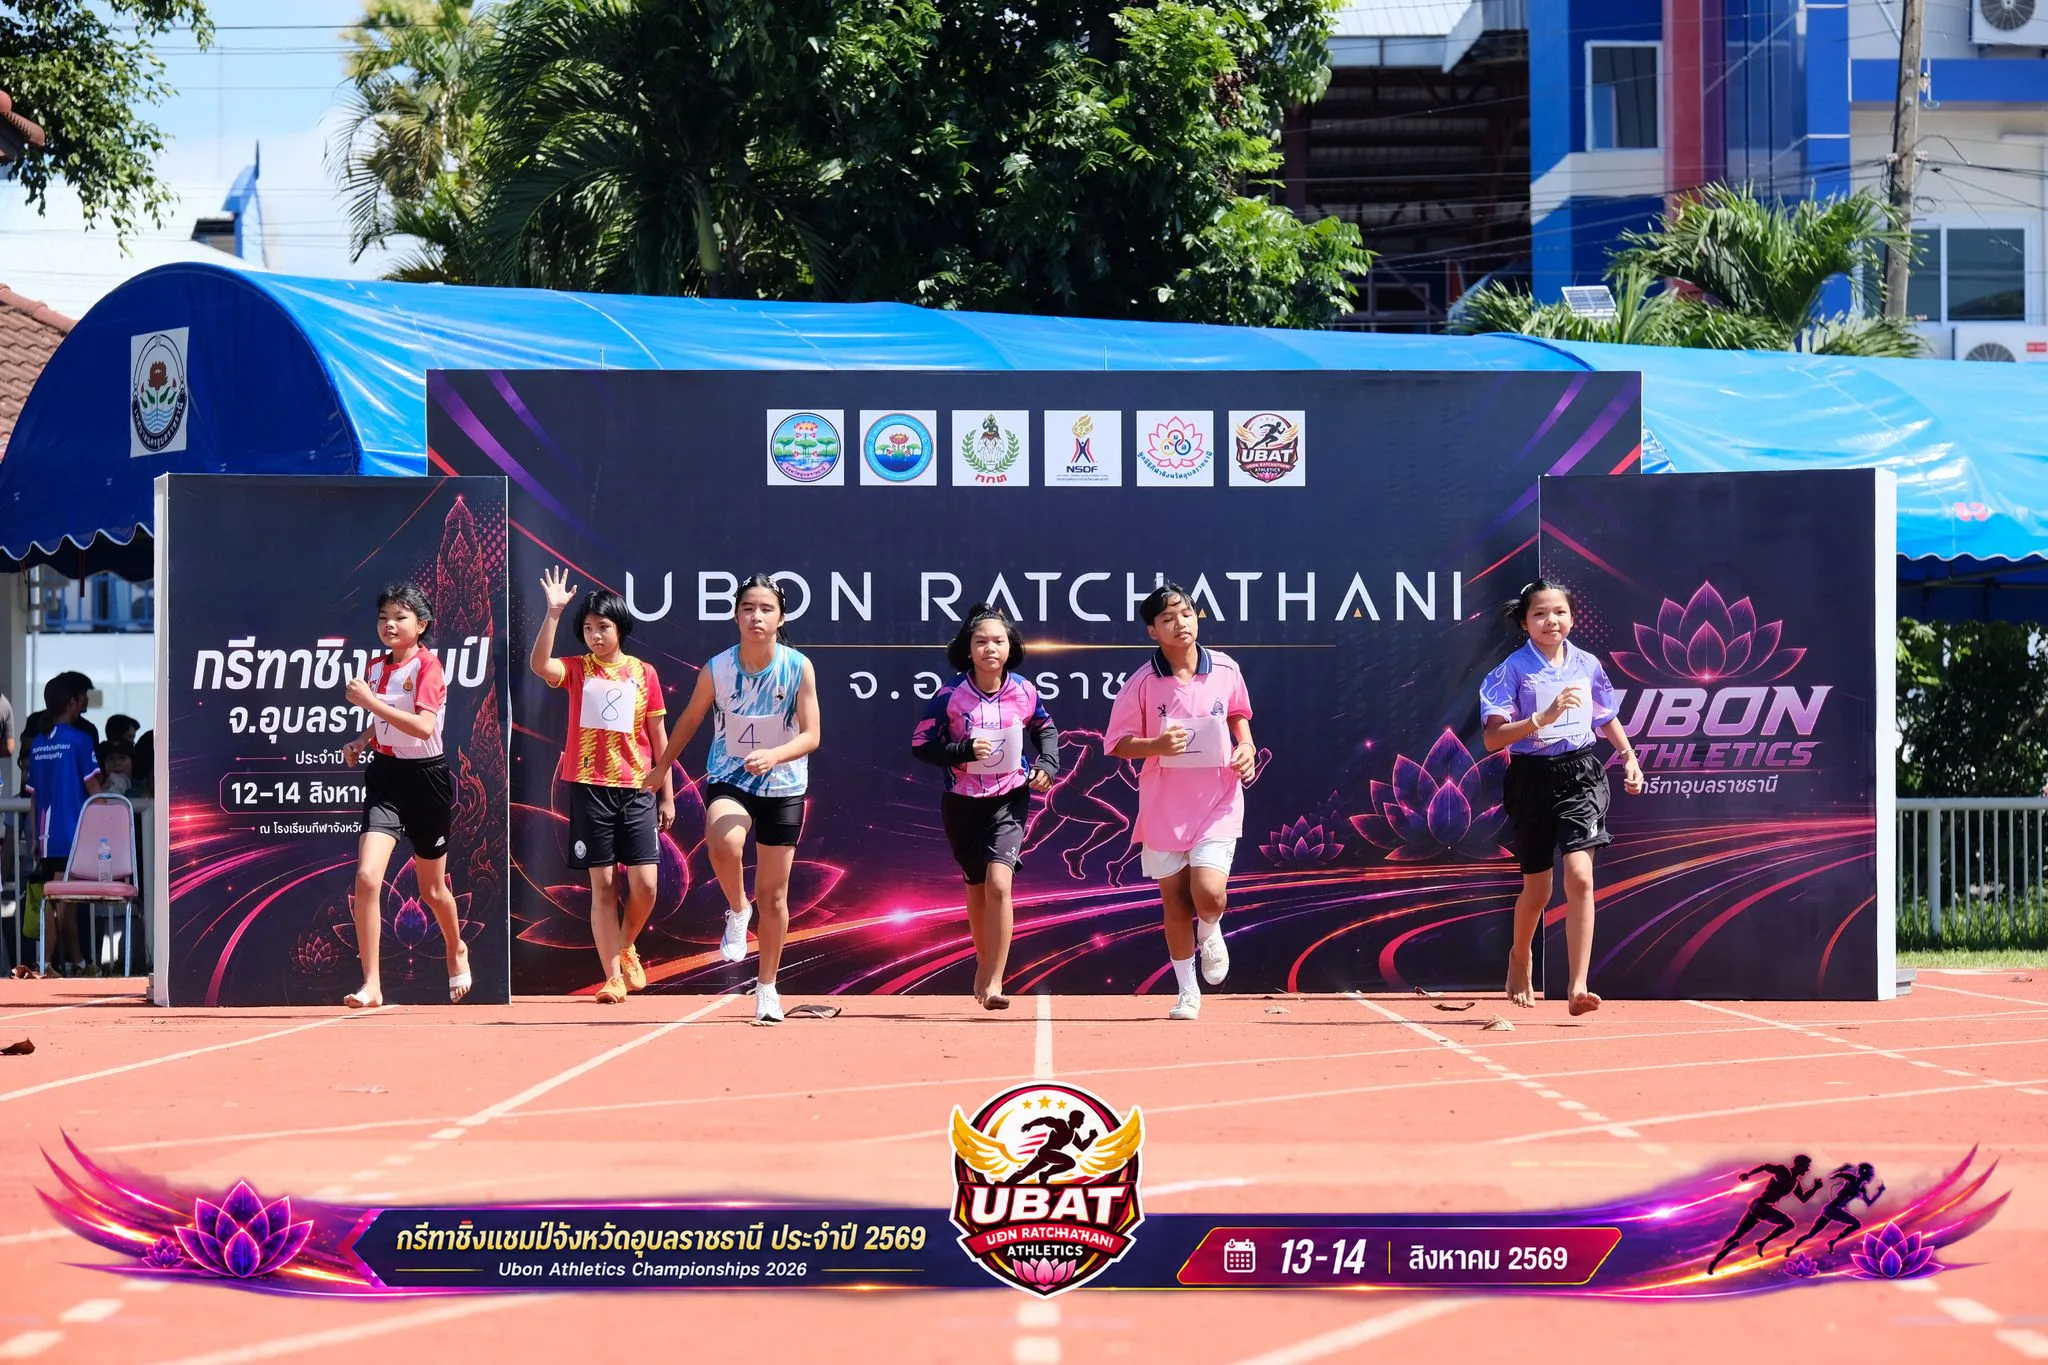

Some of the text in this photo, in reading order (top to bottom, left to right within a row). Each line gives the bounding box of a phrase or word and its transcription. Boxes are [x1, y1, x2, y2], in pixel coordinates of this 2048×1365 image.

[1066, 465, 1098, 473] NSDF
[1241, 449, 1294, 463] UBAT
[625, 571, 1462, 622] UBON RATCHATHANI
[602, 689, 622, 721] 8
[1595, 685, 1834, 738] UBON
[738, 723, 760, 749] 4
[1184, 728, 1202, 753] 2
[295, 750, 344, 765] ประจำปี
[983, 739, 1006, 768] 3
[1604, 741, 1825, 769] ATHLETICS
